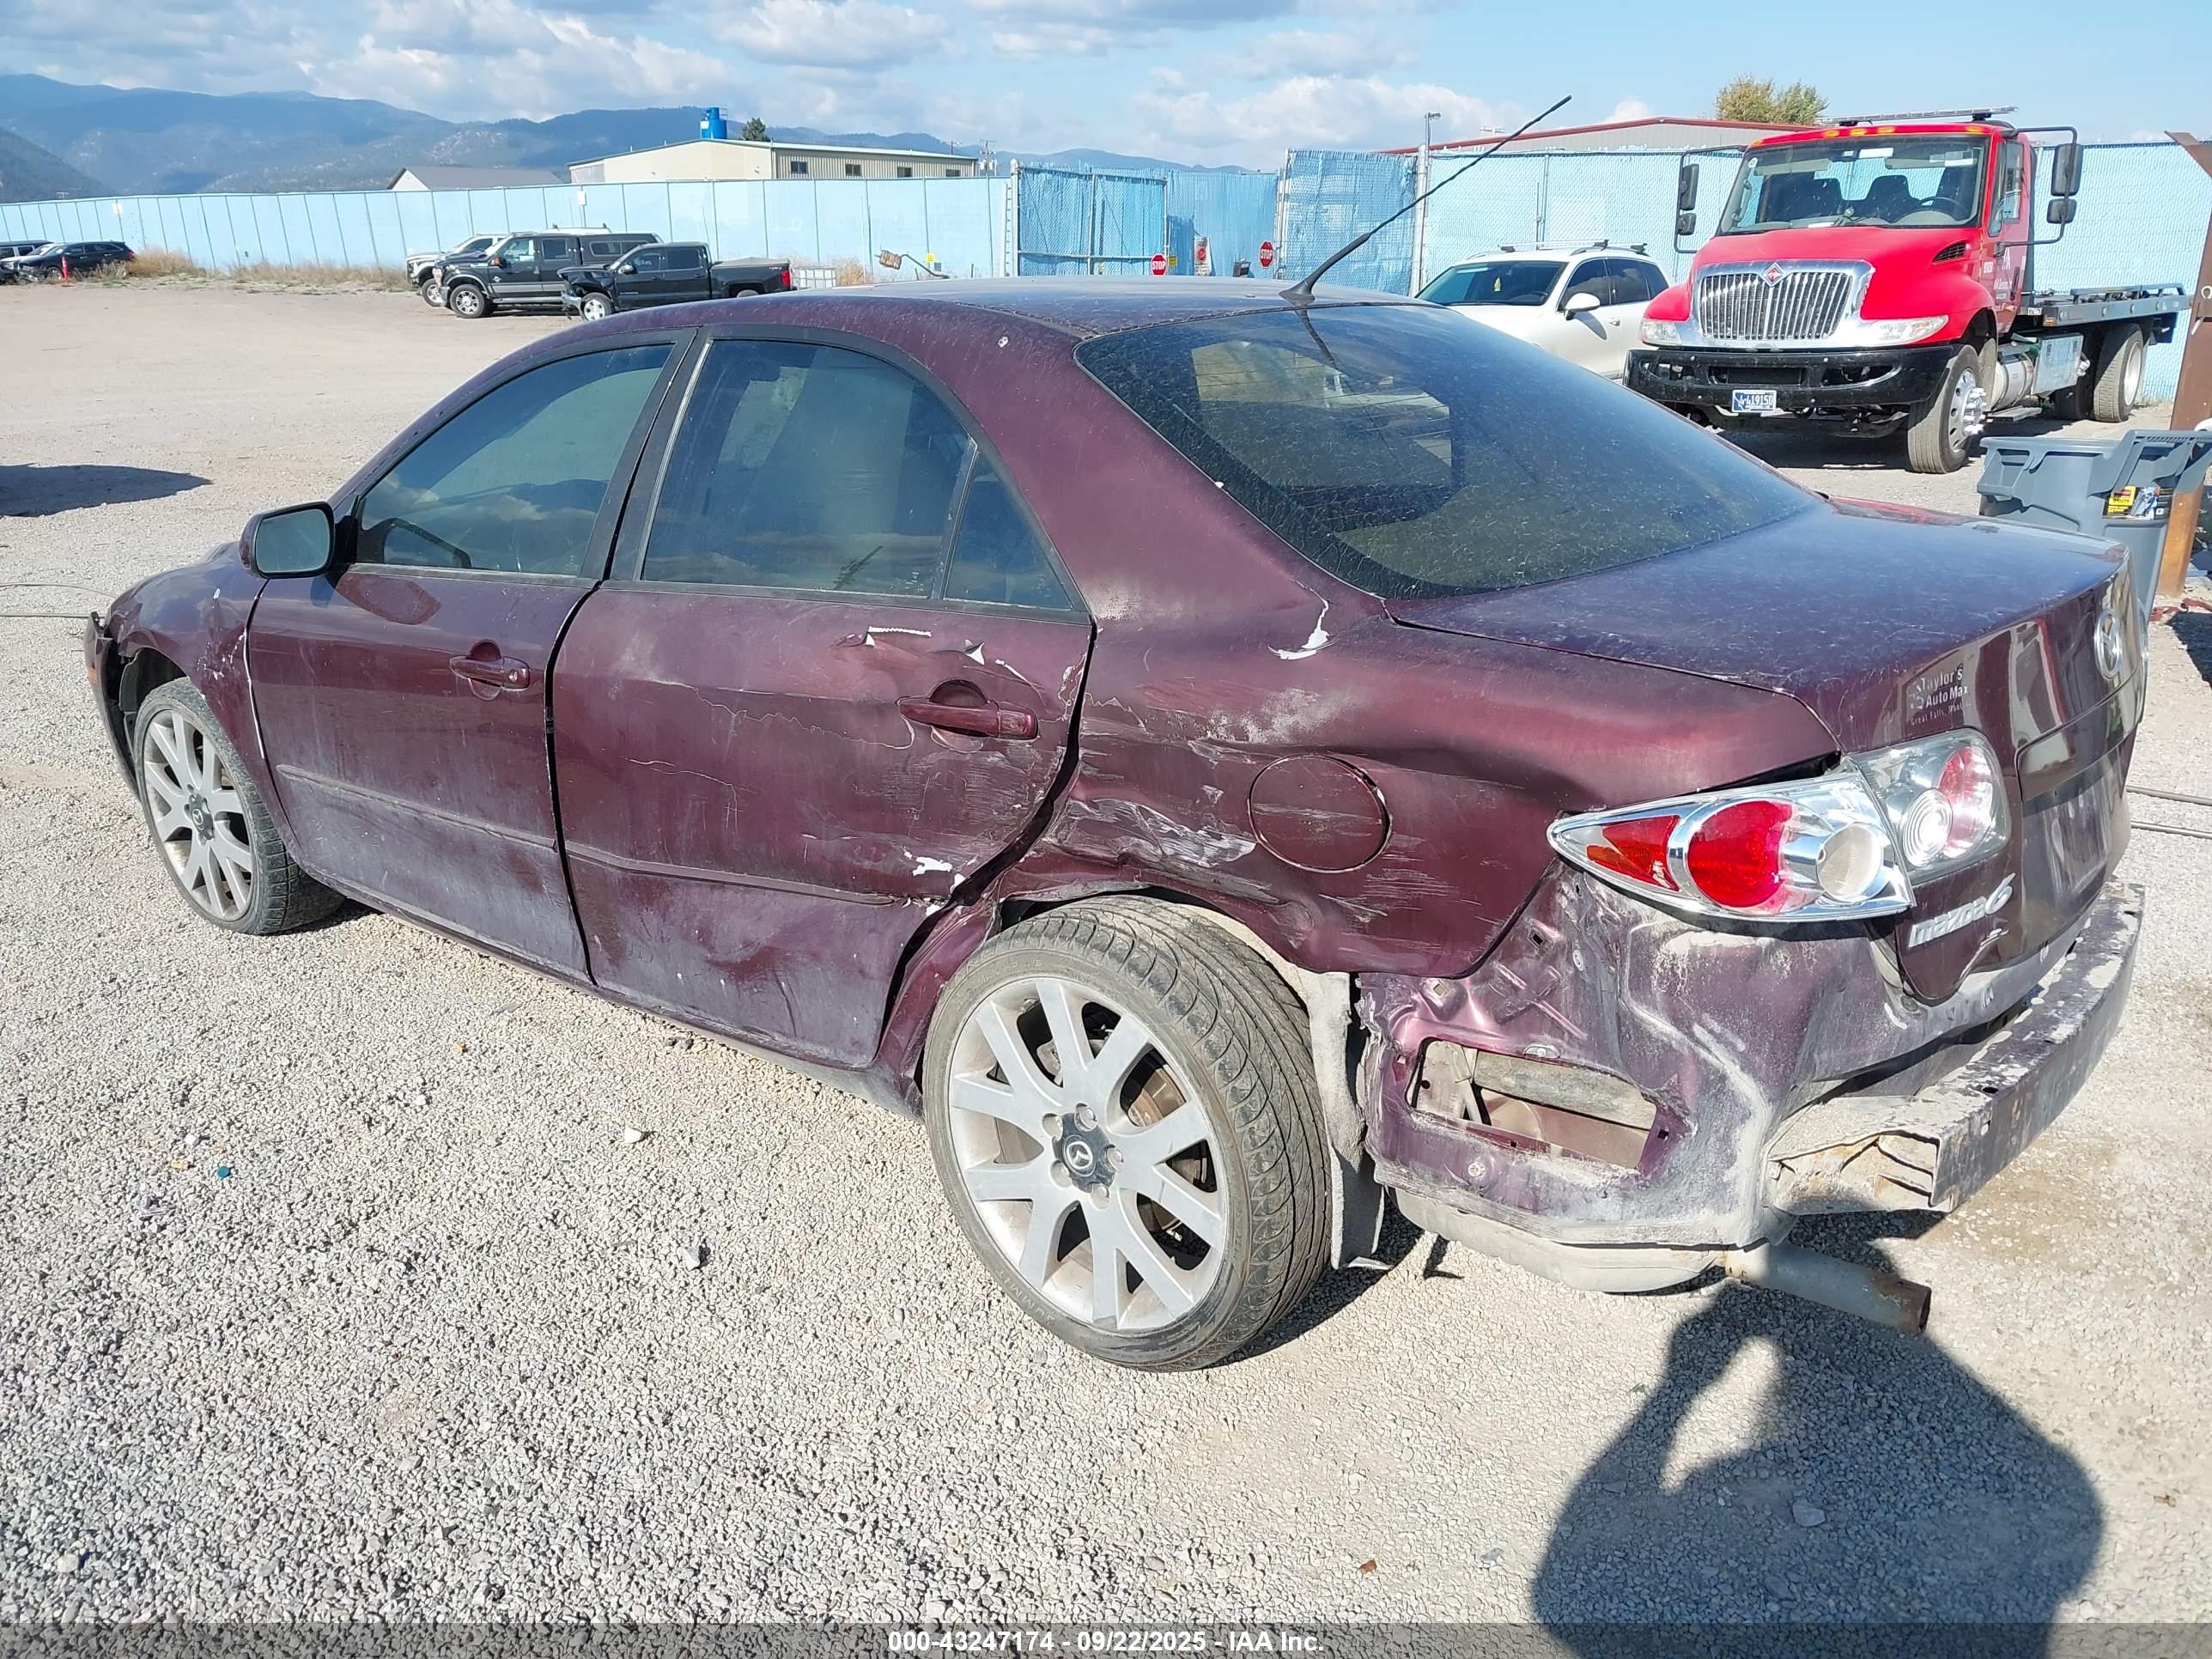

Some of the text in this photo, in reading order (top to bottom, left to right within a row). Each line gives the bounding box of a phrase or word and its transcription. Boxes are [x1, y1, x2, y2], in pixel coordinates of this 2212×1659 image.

[1260, 248, 1273, 258] STOP
[1152, 260, 1166, 270] STOP
[1920, 667, 1963, 692] Taylor's
